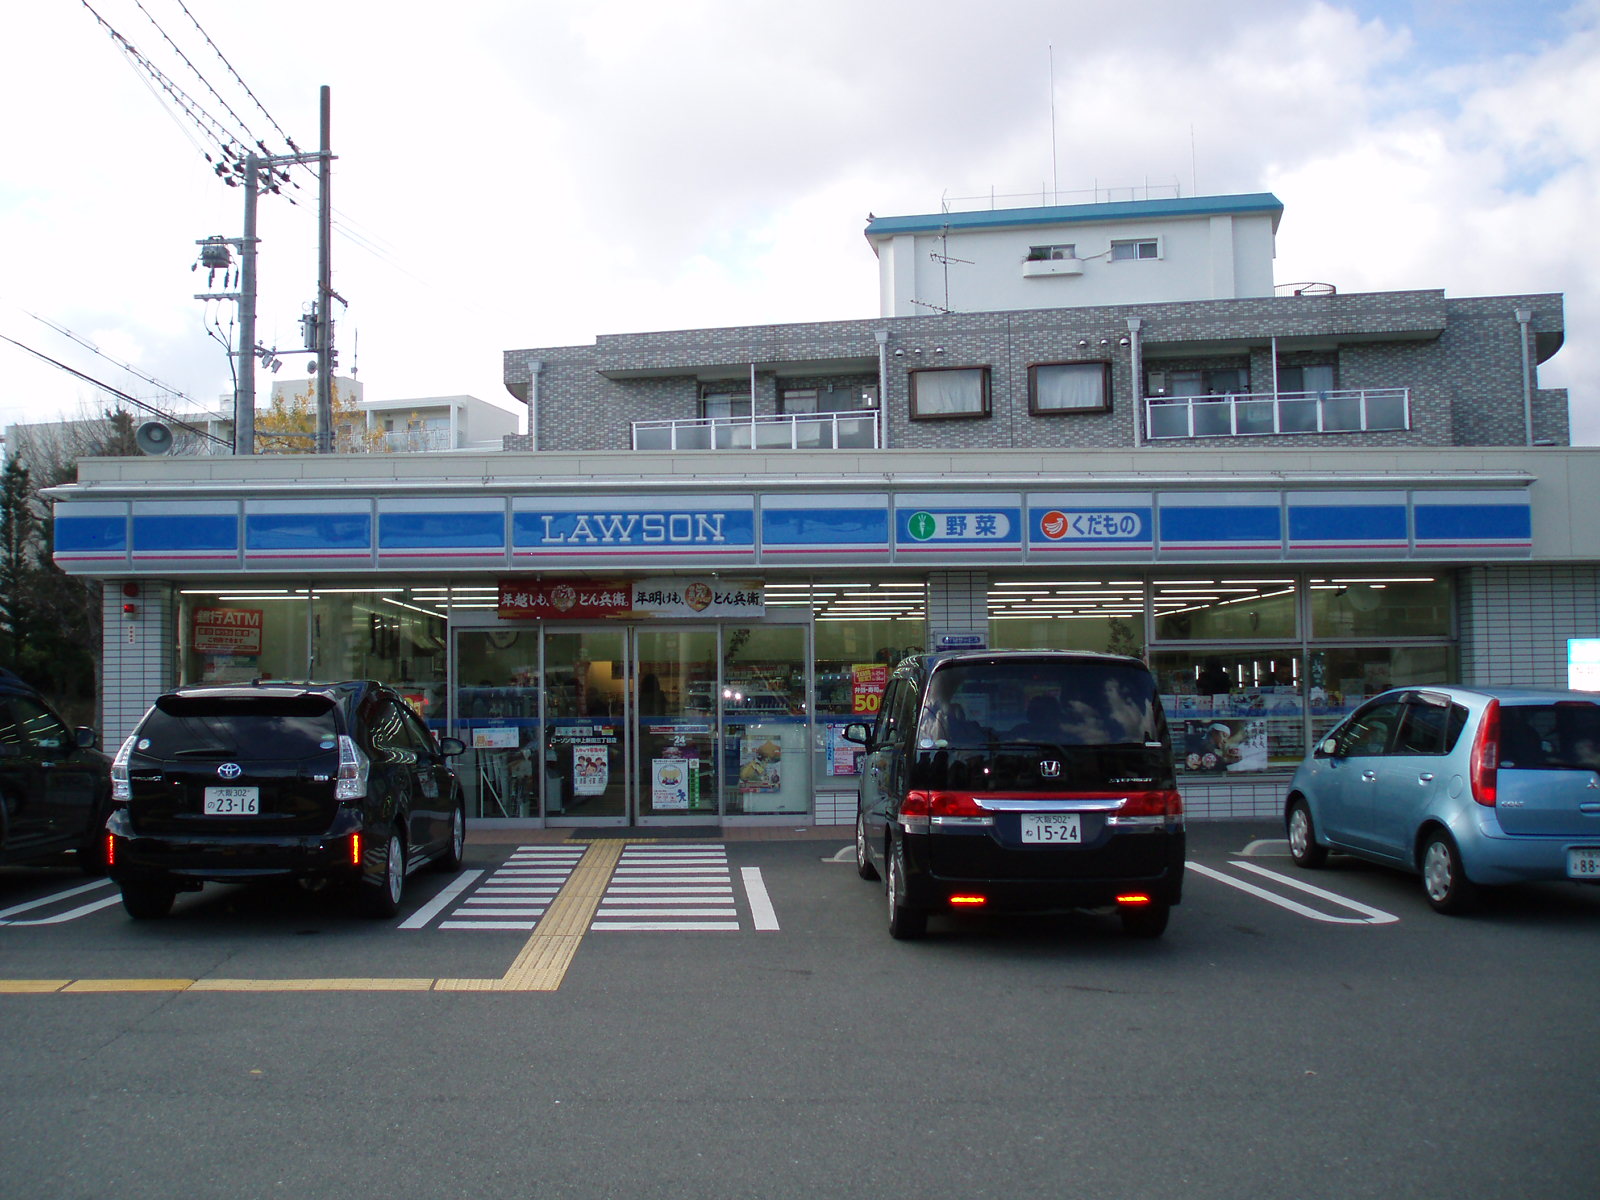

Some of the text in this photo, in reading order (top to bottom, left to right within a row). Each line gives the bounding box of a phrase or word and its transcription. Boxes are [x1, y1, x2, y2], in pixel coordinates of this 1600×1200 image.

[541, 513, 725, 543] LAWSON
[945, 514, 997, 537] 野菜
[1072, 515, 1135, 536] くだもの
[635, 590, 685, 606] 年明けも、
[216, 798, 256, 813] 23-16
[1037, 825, 1078, 841] 15-24
